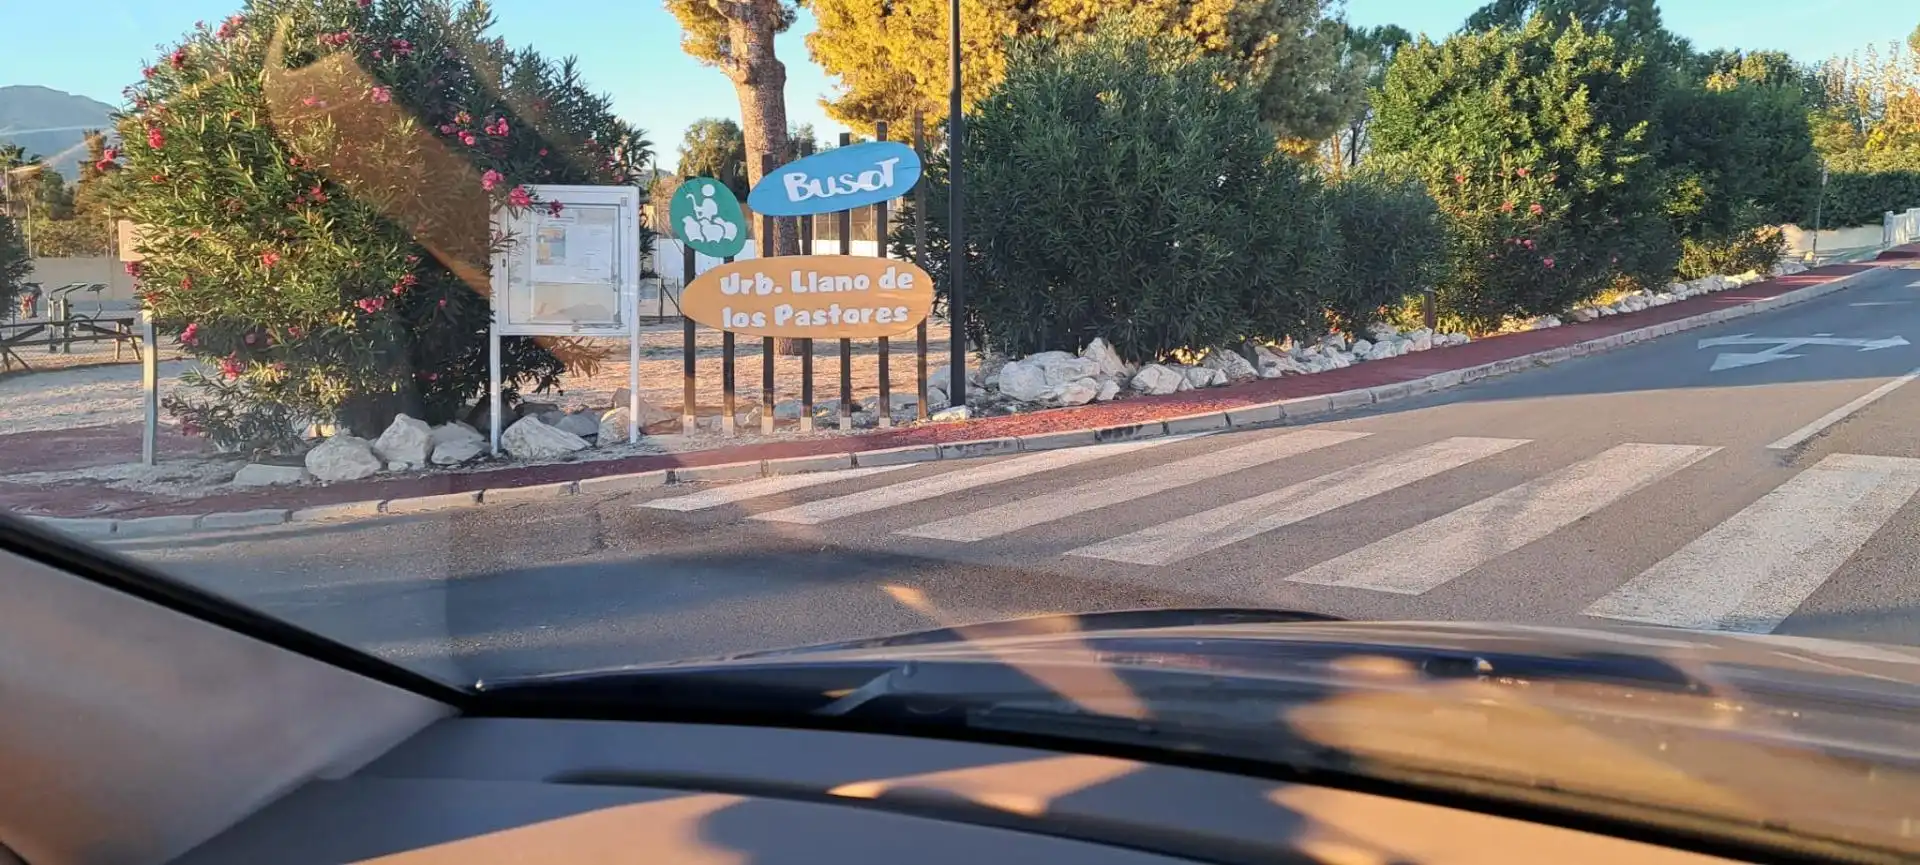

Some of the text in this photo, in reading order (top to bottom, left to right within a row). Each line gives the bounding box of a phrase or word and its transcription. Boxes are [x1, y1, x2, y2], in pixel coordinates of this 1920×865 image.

[719, 266, 914, 295] Urb. Llano de
[722, 303, 908, 328] los Pastores
